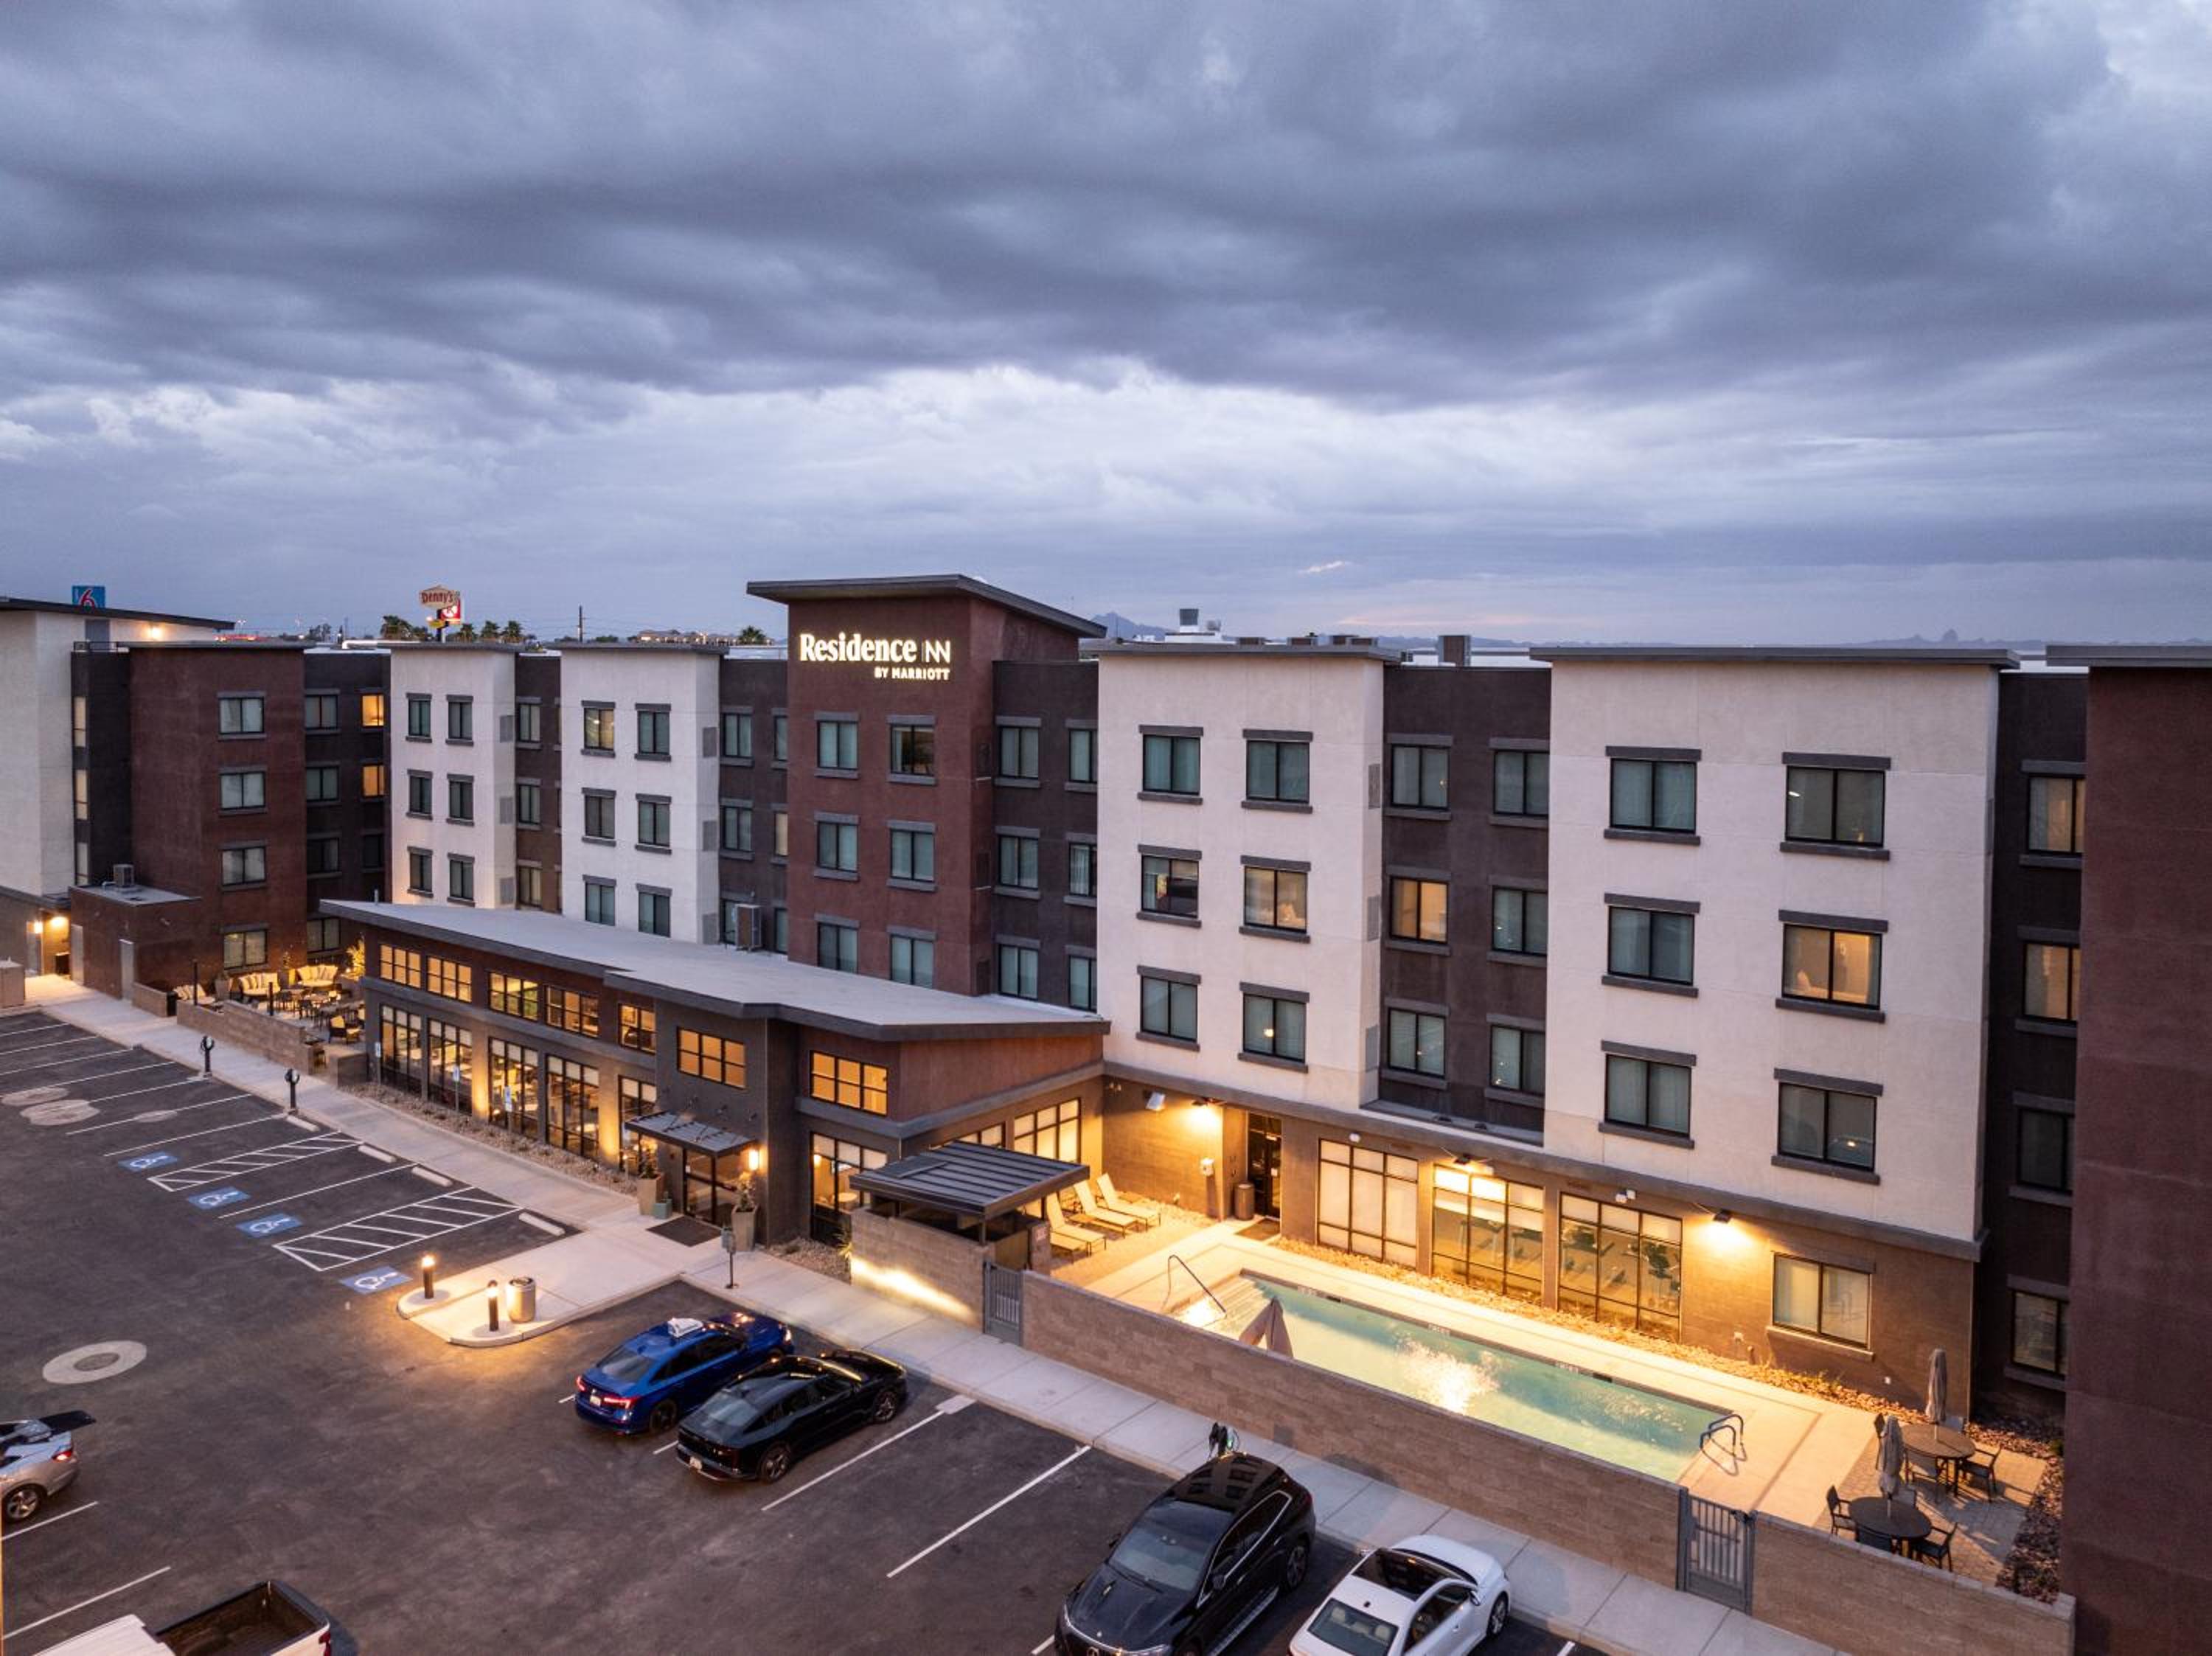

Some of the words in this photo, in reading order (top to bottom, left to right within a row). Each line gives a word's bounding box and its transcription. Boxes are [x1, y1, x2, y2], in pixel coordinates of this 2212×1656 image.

[420, 591, 453, 604] Denny's
[800, 632, 917, 663] Residence
[874, 666, 888, 678] BY
[891, 667, 950, 681] MARRIOTT
